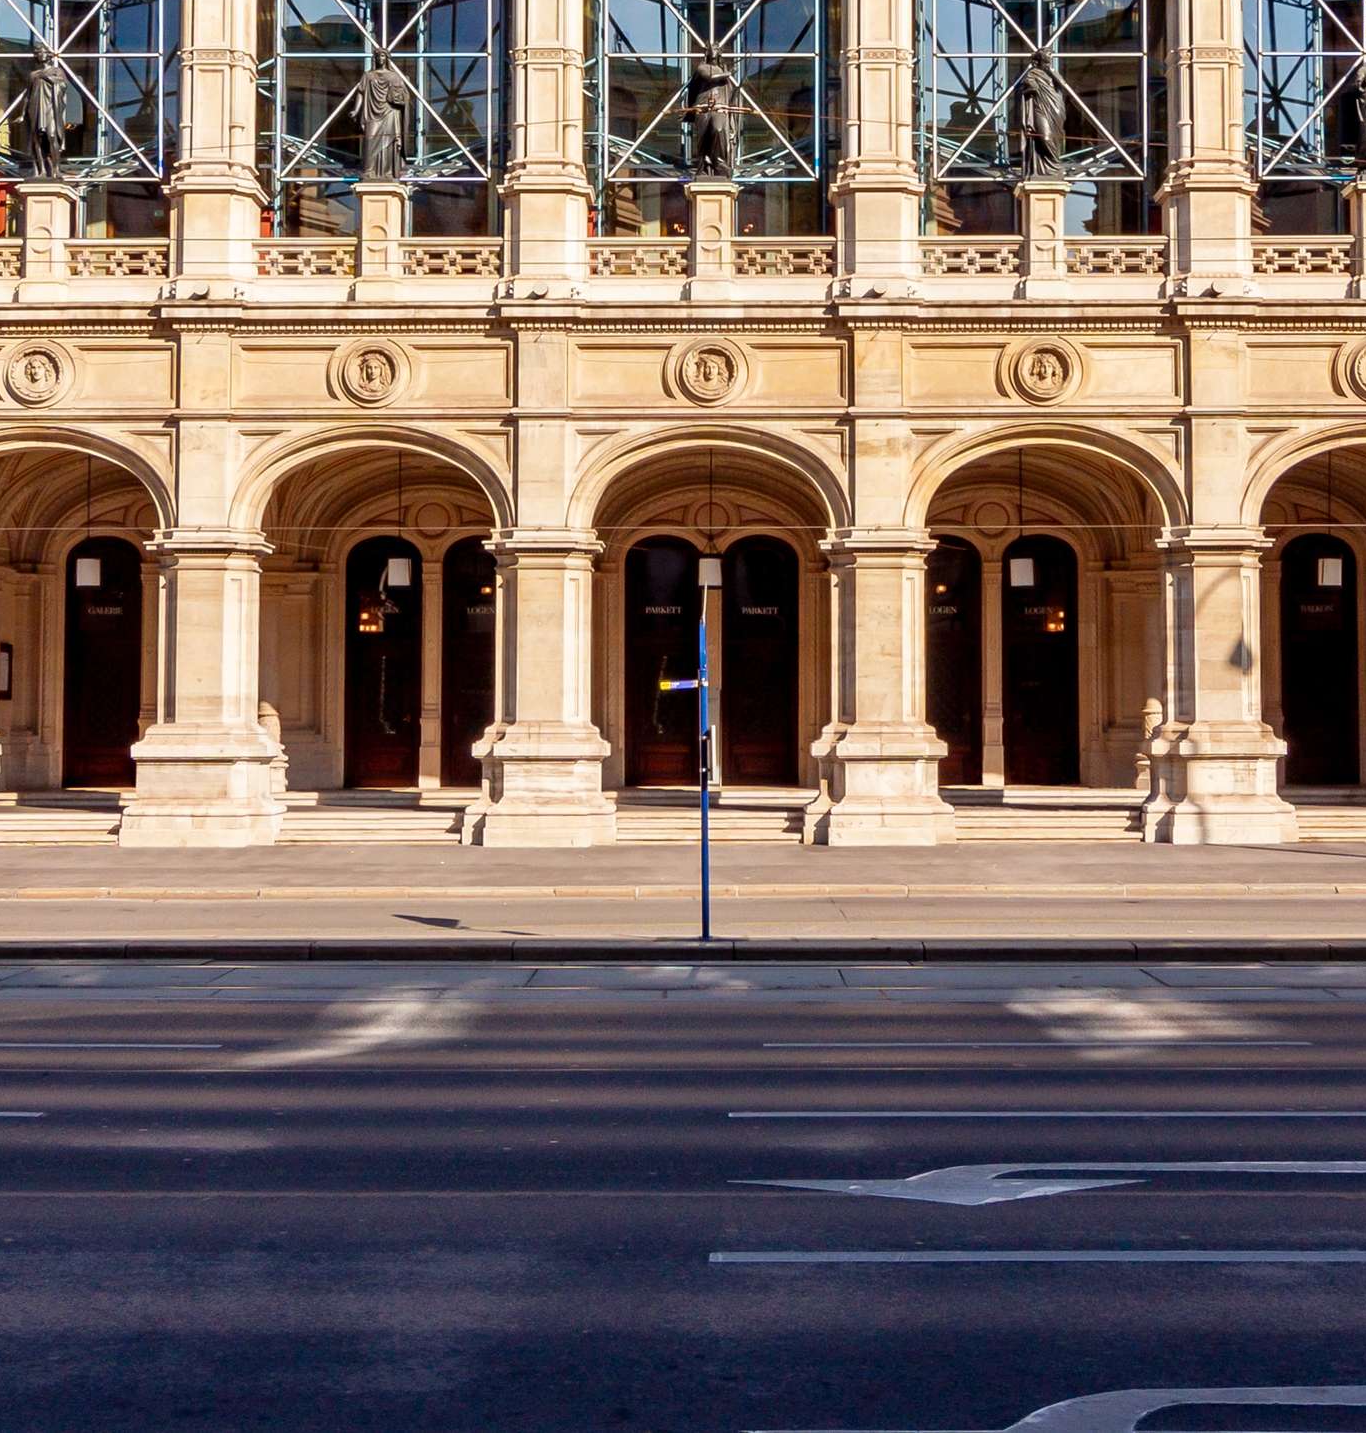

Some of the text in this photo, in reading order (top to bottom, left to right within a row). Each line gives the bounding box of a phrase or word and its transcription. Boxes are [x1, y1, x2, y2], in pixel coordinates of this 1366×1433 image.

[645, 606, 681, 614] PARKETT
[741, 606, 778, 614] PARKETT
[928, 606, 957, 614] LOGEN
